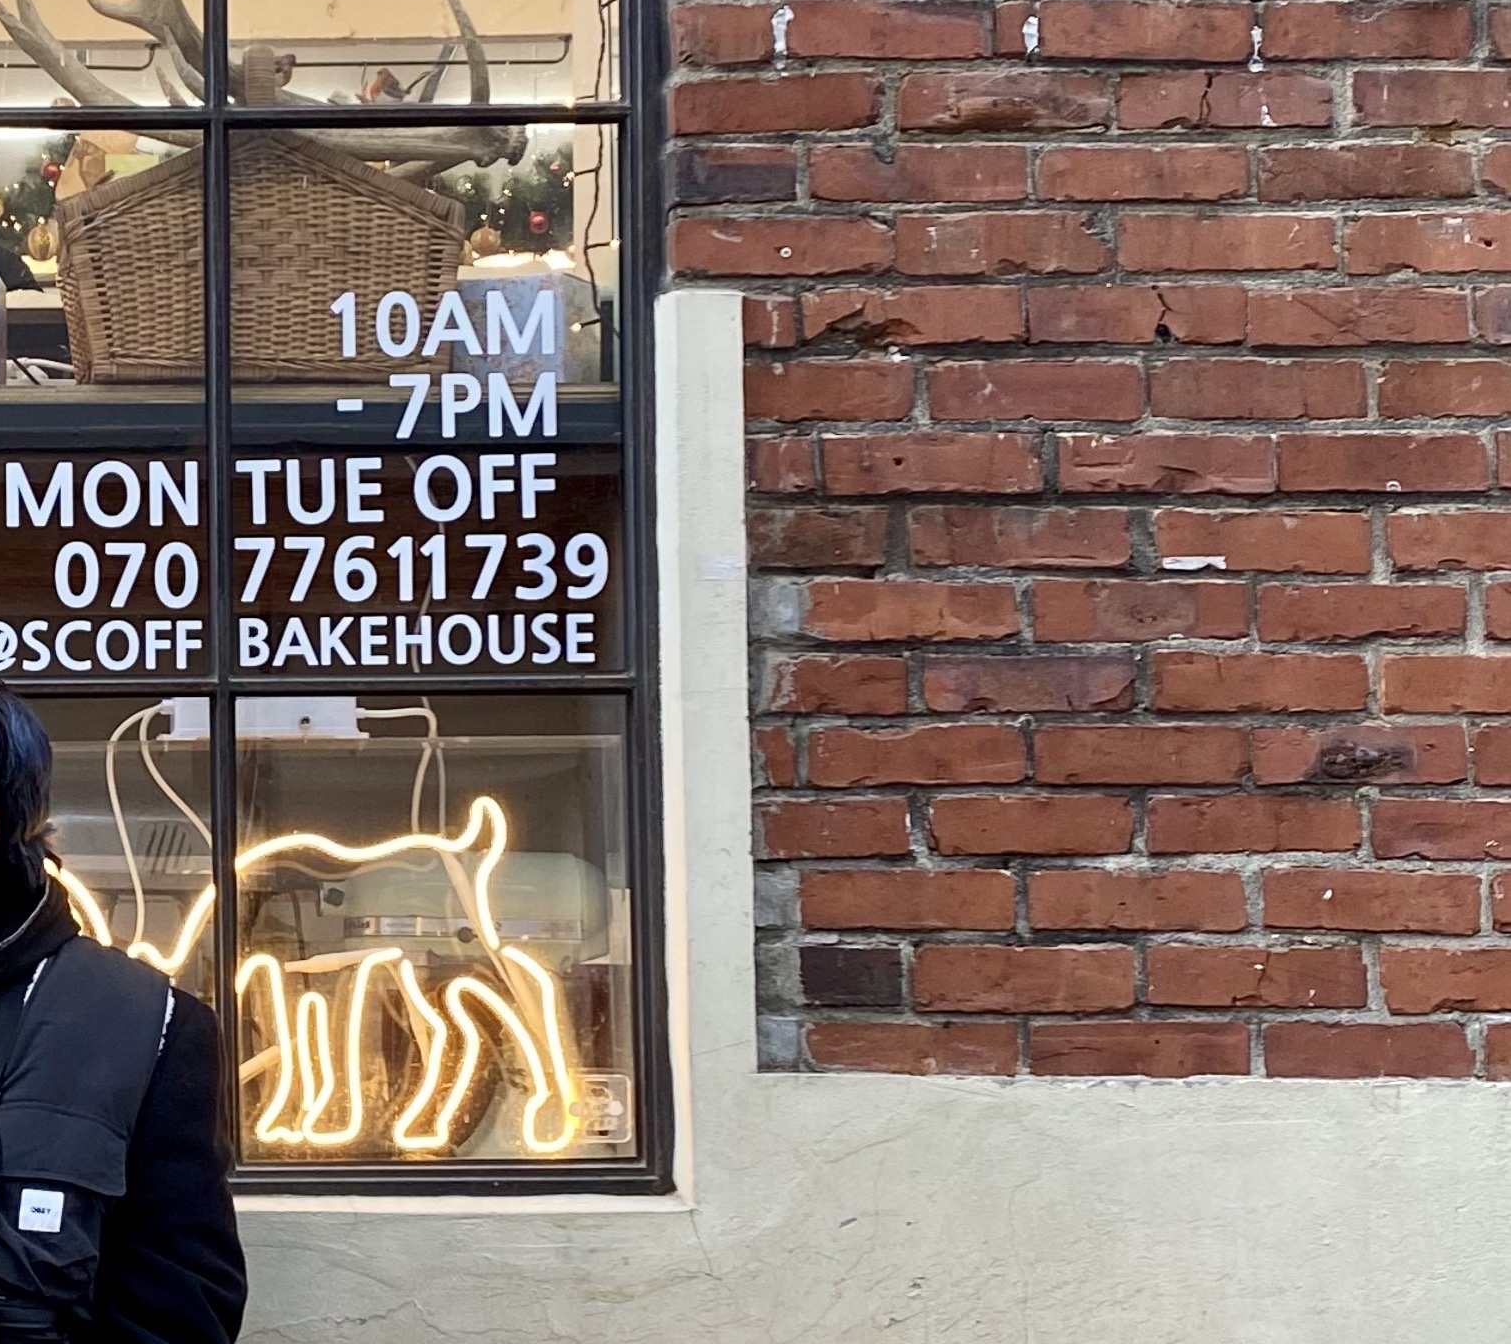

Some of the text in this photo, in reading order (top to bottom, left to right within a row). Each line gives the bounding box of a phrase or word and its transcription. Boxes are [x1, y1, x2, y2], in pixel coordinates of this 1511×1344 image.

[329, 290, 557, 359] 10AM
[389, 370, 559, 440] 7PM
[5, 452, 557, 529] MON TUE OFF
[54, 532, 609, 610] 070 77611739
[239, 612, 597, 668] BAKEHOUSE
